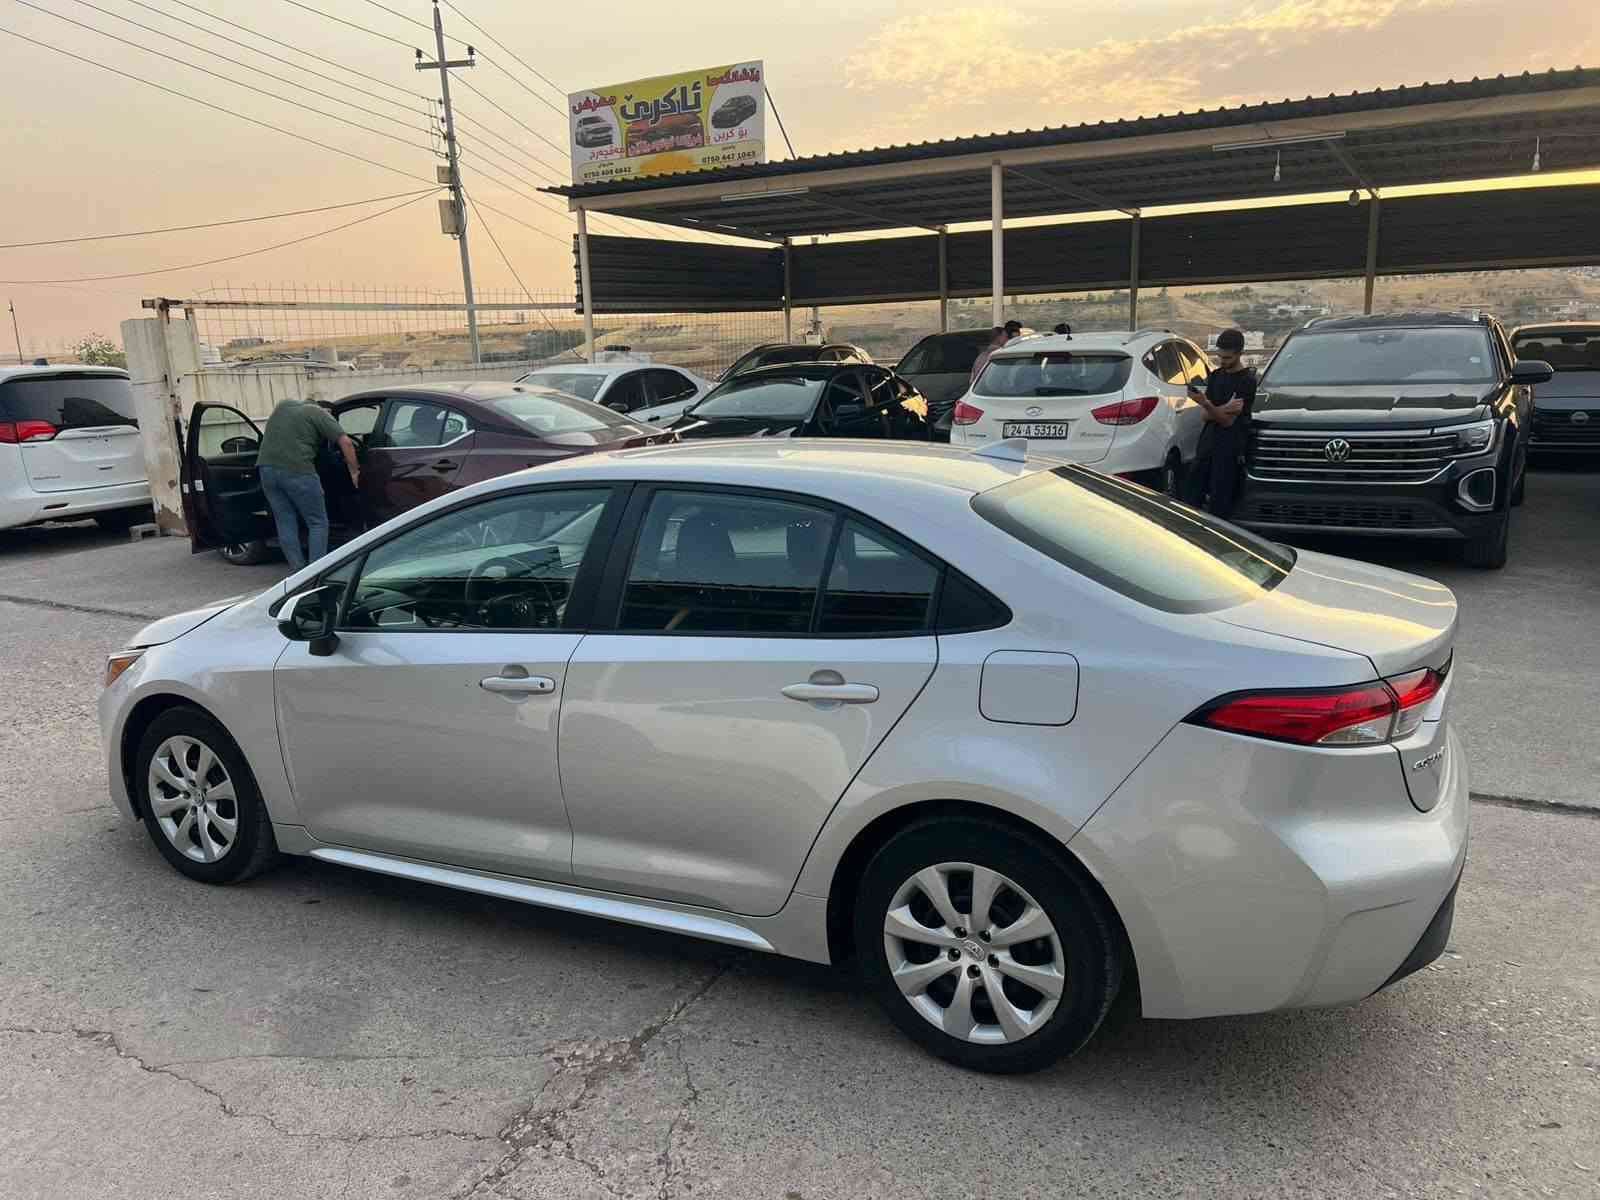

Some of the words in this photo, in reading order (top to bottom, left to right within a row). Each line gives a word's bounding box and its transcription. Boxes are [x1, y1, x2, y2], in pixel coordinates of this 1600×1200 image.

[1010, 425, 1022, 436] 24
[1025, 425, 1031, 435] A
[1034, 424, 1064, 436] 53116
